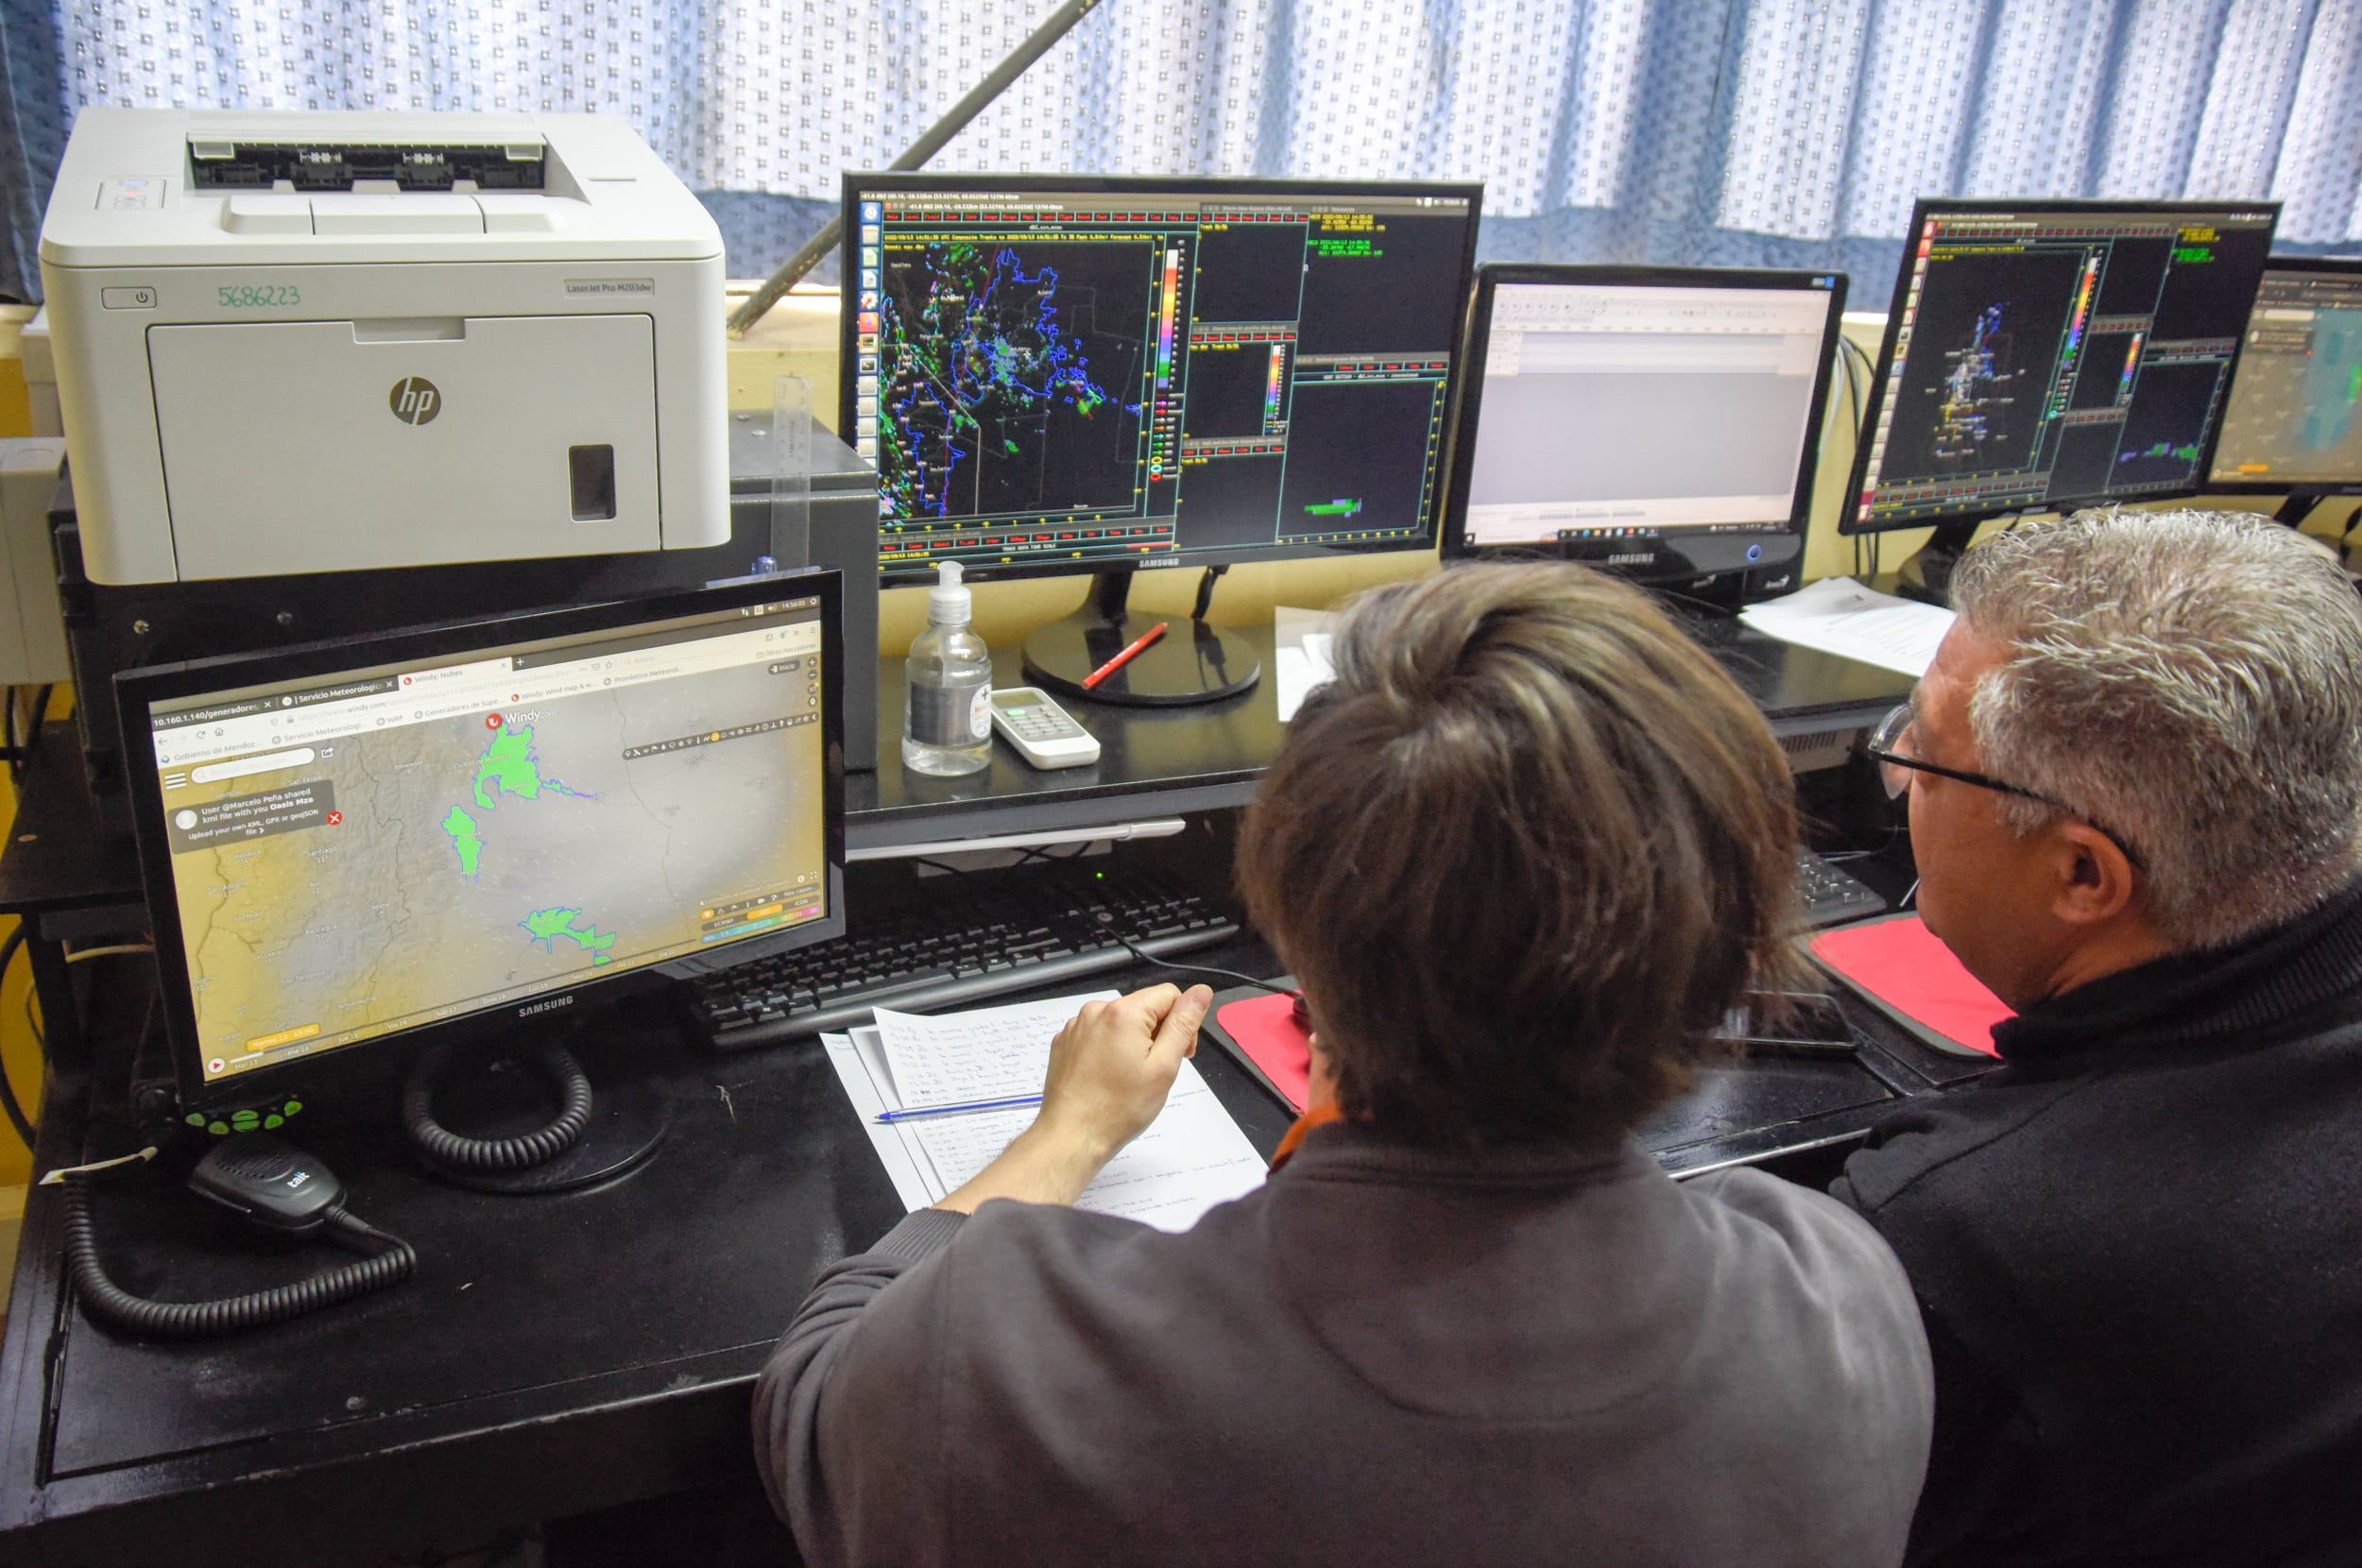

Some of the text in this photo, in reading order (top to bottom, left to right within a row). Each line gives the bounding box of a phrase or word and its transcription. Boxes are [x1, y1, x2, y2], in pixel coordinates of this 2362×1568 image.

[567, 283, 591, 293] LaserJet
[592, 283, 607, 292] Pro
[218, 285, 300, 307] 5686223
[397, 377, 435, 425] hp
[1139, 557, 1179, 567] SAMSUNG
[1608, 554, 1654, 564] SAMSUNG
[779, 663, 796, 672] Inicio
[440, 671, 463, 679] Nubes
[545, 686, 563, 695] Wind
[564, 684, 578, 693] map
[299, 690, 329, 703] Servicio
[425, 703, 470, 717] Generadores
[284, 729, 315, 741] Servicio
[174, 749, 211, 761] Gobierno
[201, 788, 311, 815] User @Marcelo Peña shared
[202, 796, 314, 825] kml file with you Oasis Mza
[188, 829, 214, 841] Upload
[214, 827, 230, 837] your
[265, 816, 280, 825] GPX
[246, 827, 257, 836] file
[519, 996, 573, 1017] SAMSUNG
[287, 1171, 310, 1187] tait
